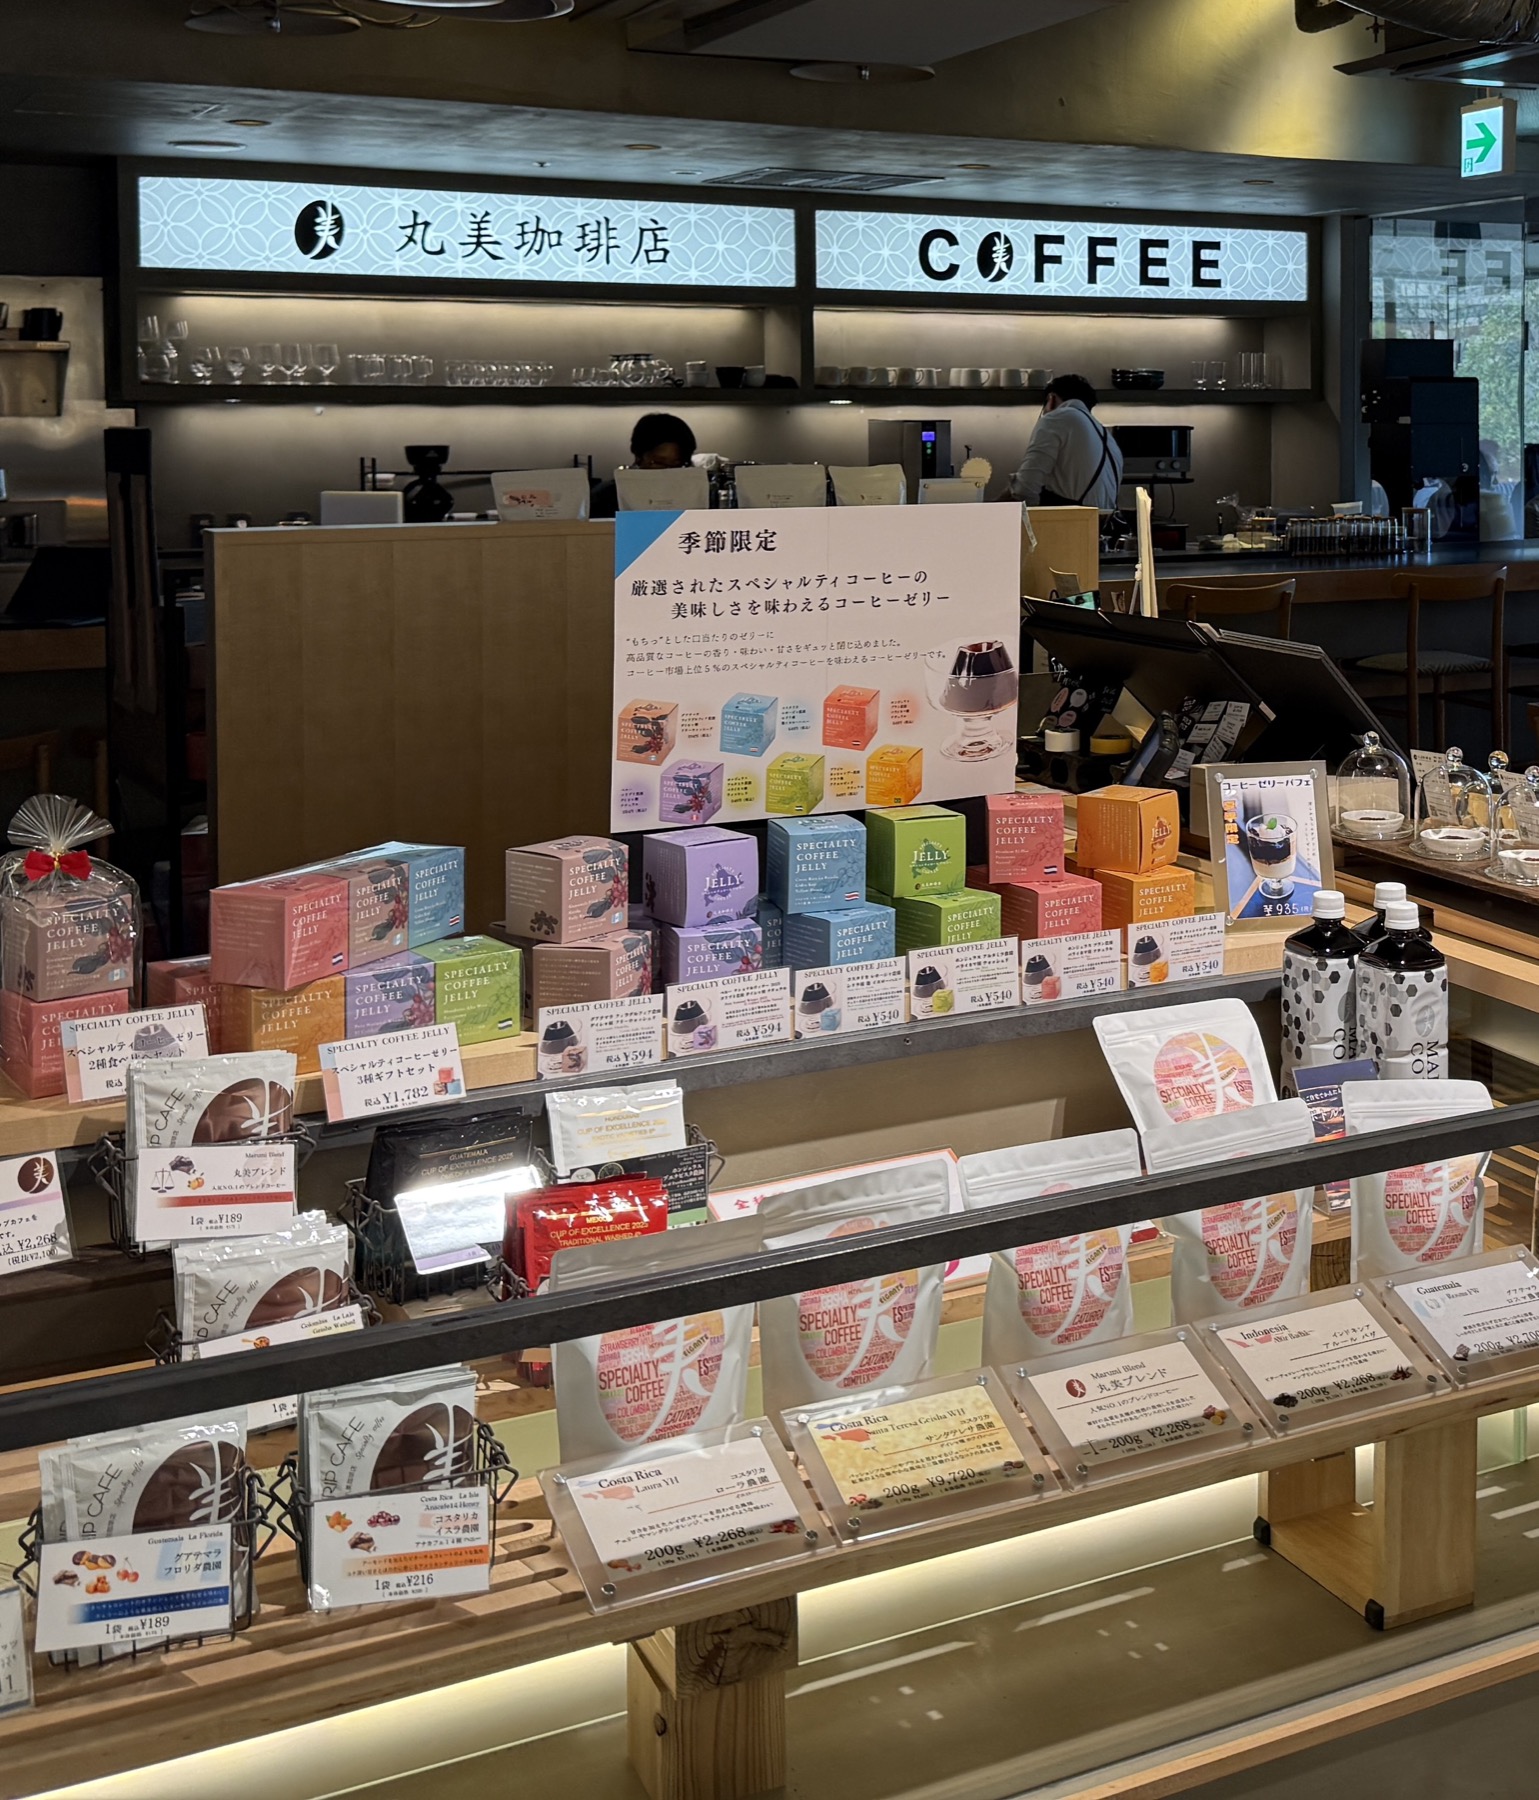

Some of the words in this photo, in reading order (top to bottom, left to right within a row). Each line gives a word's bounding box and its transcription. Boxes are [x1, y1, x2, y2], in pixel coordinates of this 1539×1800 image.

[396, 210, 671, 266] 丸美珈琲店
[678, 529, 778, 554] 季節限定
[631, 570, 928, 597] 厳選されたスペシャルティコーヒーの
[671, 591, 951, 620] 美味しさを味わえるコーヒーゼリー
[1222, 778, 1311, 791] コーヒーゼリーパフェ
[996, 815, 1055, 826] SPECIALTY
[996, 826, 1037, 836] COFFEE
[796, 838, 857, 851] SPECIALTY
[995, 836, 1027, 846] JELLY
[796, 850, 839, 861] COFFEE
[911, 850, 949, 864] JELLY
[415, 857, 460, 880] SPECIALTY
[569, 857, 622, 876] SPECIALTY
[795, 862, 827, 874] JELLY
[356, 876, 402, 897] SPECIALTY
[415, 876, 448, 891] COFFEE
[569, 871, 608, 888] COFFEE
[704, 875, 743, 892] JELLY
[414, 888, 440, 904] JELLY
[568, 885, 598, 901] JELLY
[1139, 882, 1188, 897] SPECIALTY
[292, 894, 343, 915] SPECIALTY
[356, 892, 390, 909] COFFEE
[1045, 894, 1095, 909] SPECIALTY
[1139, 895, 1174, 906] COFFEE
[46, 907, 120, 926] SPECIALTY
[292, 910, 329, 928] COFFEE
[355, 905, 382, 923] JELLY
[947, 906, 997, 923] SPECIALTY
[1045, 906, 1081, 919] COFFEE
[1138, 906, 1166, 918] JELLY
[47, 923, 99, 939] COFFEE
[837, 920, 889, 938] SPECIALTY
[947, 920, 982, 934] COFFEE
[1044, 918, 1072, 930] JELLY
[292, 924, 320, 942] JELLY
[837, 934, 874, 948] COFFEE
[946, 932, 973, 945] JELLY
[46, 938, 87, 954] JELLY
[687, 939, 752, 954] SPECIALTY
[836, 946, 865, 961] JELLY
[917, 948, 954, 959] SPECIALTY
[957, 943, 985, 953] COFFEE
[986, 940, 1008, 950] JELLY
[687, 950, 734, 965] COFFEE
[1195, 960, 1219, 971] ¥540
[444, 961, 510, 980] SPECIALTY
[686, 963, 721, 978] JELLY
[804, 968, 843, 979] SPECIALTY
[846, 963, 875, 973] COFFEE
[876, 960, 898, 970] JELLY
[355, 975, 424, 993] SPECIALTY
[444, 977, 491, 992] COFFEE
[677, 981, 719, 993] SPECIALTY
[722, 975, 753, 985] COFFEE
[755, 971, 778, 981] JELLY
[1090, 977, 1114, 989] ¥540
[355, 991, 404, 1007] COFFEE
[443, 989, 480, 1006] JELLY
[985, 990, 1012, 1002] ¥540
[354, 1004, 392, 1020] JELLY
[546, 1005, 591, 1016] SPECIALTY
[594, 1000, 625, 1010] COFFEE
[628, 997, 653, 1007] JELLY
[69, 1018, 123, 1033] SPECIALTY
[126, 1012, 164, 1025] COFFEE
[167, 1008, 196, 1022] JELLY
[872, 1009, 900, 1022] ¥540
[752, 1022, 782, 1035] ¥594
[327, 1039, 379, 1055] SPECIALTY
[382, 1032, 419, 1046] COFFEE
[421, 1027, 450, 1040] JELLY
[332, 1047, 457, 1075] スペシャルティコーヒーゼリー
[623, 1049, 653, 1062] ¥594
[357, 1063, 436, 1086] 3種ギフトセット
[382, 1086, 429, 1105] ¥1,782
[1184, 1094, 1216, 1109] COFFEE
[234, 1167, 286, 1178] 丸美ブレンド
[421, 1167, 437, 1177] CUP
[450, 1158, 497, 1170] EXCELLENCE
[1406, 1208, 1437, 1224] COFFEE
[549, 1230, 567, 1239] CUP
[568, 1228, 580, 1236] OF
[581, 1223, 631, 1236] EXCELLENCE
[17, 1232, 58, 1251] ¥2,268
[1228, 1249, 1257, 1268] COFFEE
[1040, 1284, 1073, 1304] COFFEE
[825, 1324, 862, 1346] COFFEE
[1474, 1340, 1505, 1354] 200g
[1122, 1362, 1147, 1373] Blend
[1096, 1368, 1168, 1394] 丸美ブレンド
[1297, 1386, 1331, 1401] 200g
[1332, 1373, 1376, 1391] ¥2,268
[625, 1379, 666, 1404] COFFEE
[863, 1413, 889, 1428] Rica
[925, 1421, 996, 1443] サンタテレサ農園
[1109, 1433, 1143, 1450] 200g
[1146, 1419, 1192, 1439] ¥2,268
[597, 1473, 636, 1491] Costa
[636, 1467, 663, 1483] Rica
[730, 1467, 767, 1481] コスタリカ
[634, 1482, 662, 1494] Laura
[716, 1475, 770, 1494] ローラ農園
[883, 1483, 921, 1499] 200g
[926, 1467, 976, 1489] ¥9,720
[435, 1512, 479, 1524] コスタリカ
[435, 1523, 480, 1536] イスラ農園
[643, 1543, 685, 1562] 200g
[692, 1526, 748, 1549] ¥2,268
[175, 1548, 222, 1564] グアテマラ
[164, 1560, 222, 1577] フロリダ農園
[375, 1579, 391, 1591] 1袋
[105, 1623, 122, 1635] 1袋
